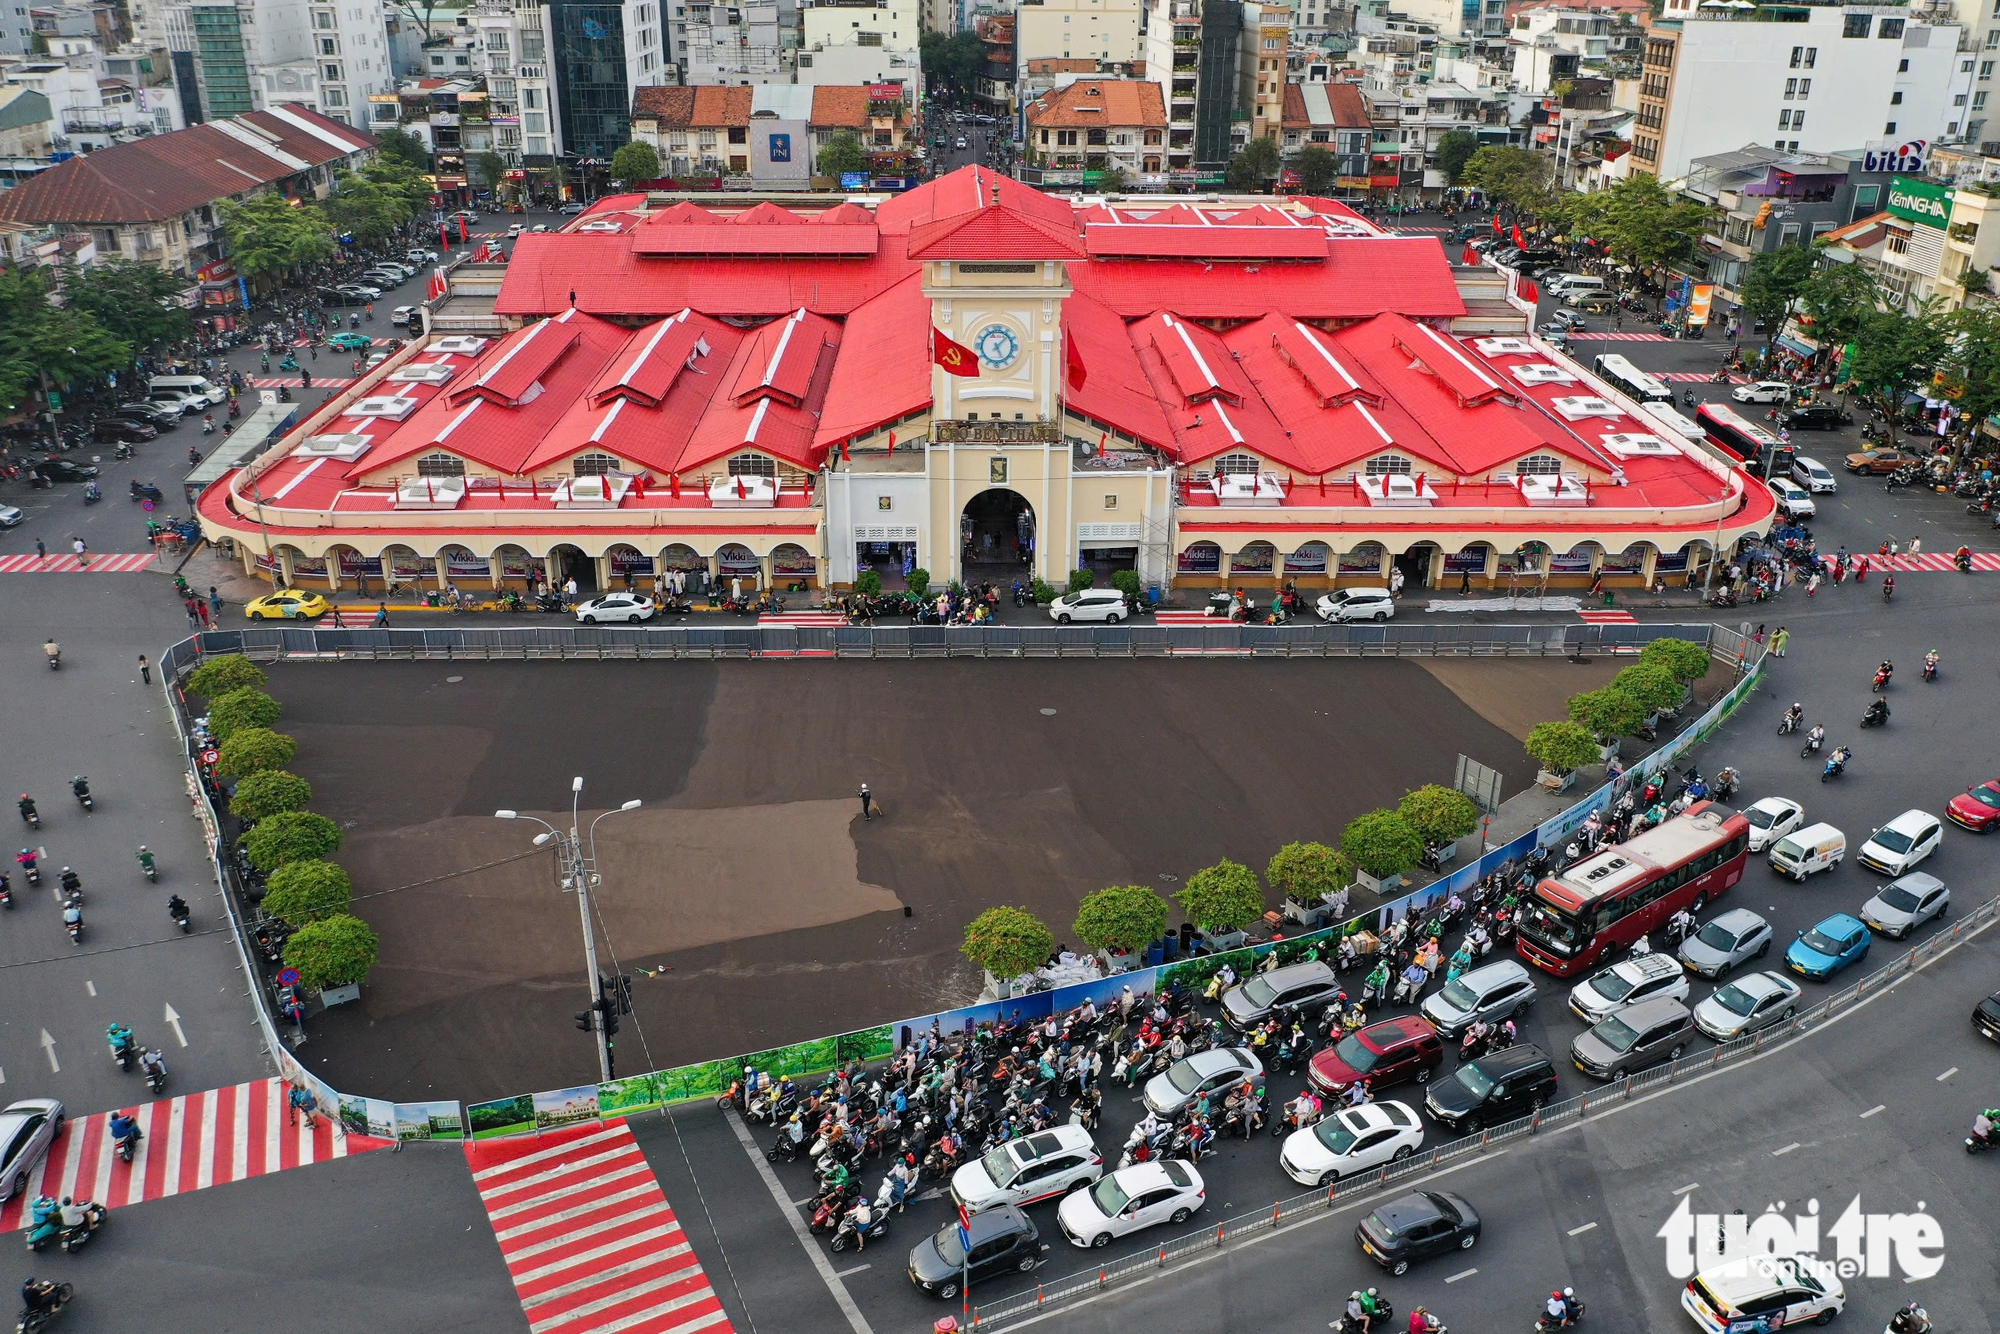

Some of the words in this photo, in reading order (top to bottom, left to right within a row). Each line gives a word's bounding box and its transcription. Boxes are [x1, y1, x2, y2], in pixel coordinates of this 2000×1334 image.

[773, 149, 788, 158] PNJ
[342, 549, 366, 563] Vikki
[449, 550, 474, 562] Vikki
[612, 549, 638, 562] Vikki
[722, 550, 746, 561] Vikki
[1184, 547, 1206, 559] Vikki
